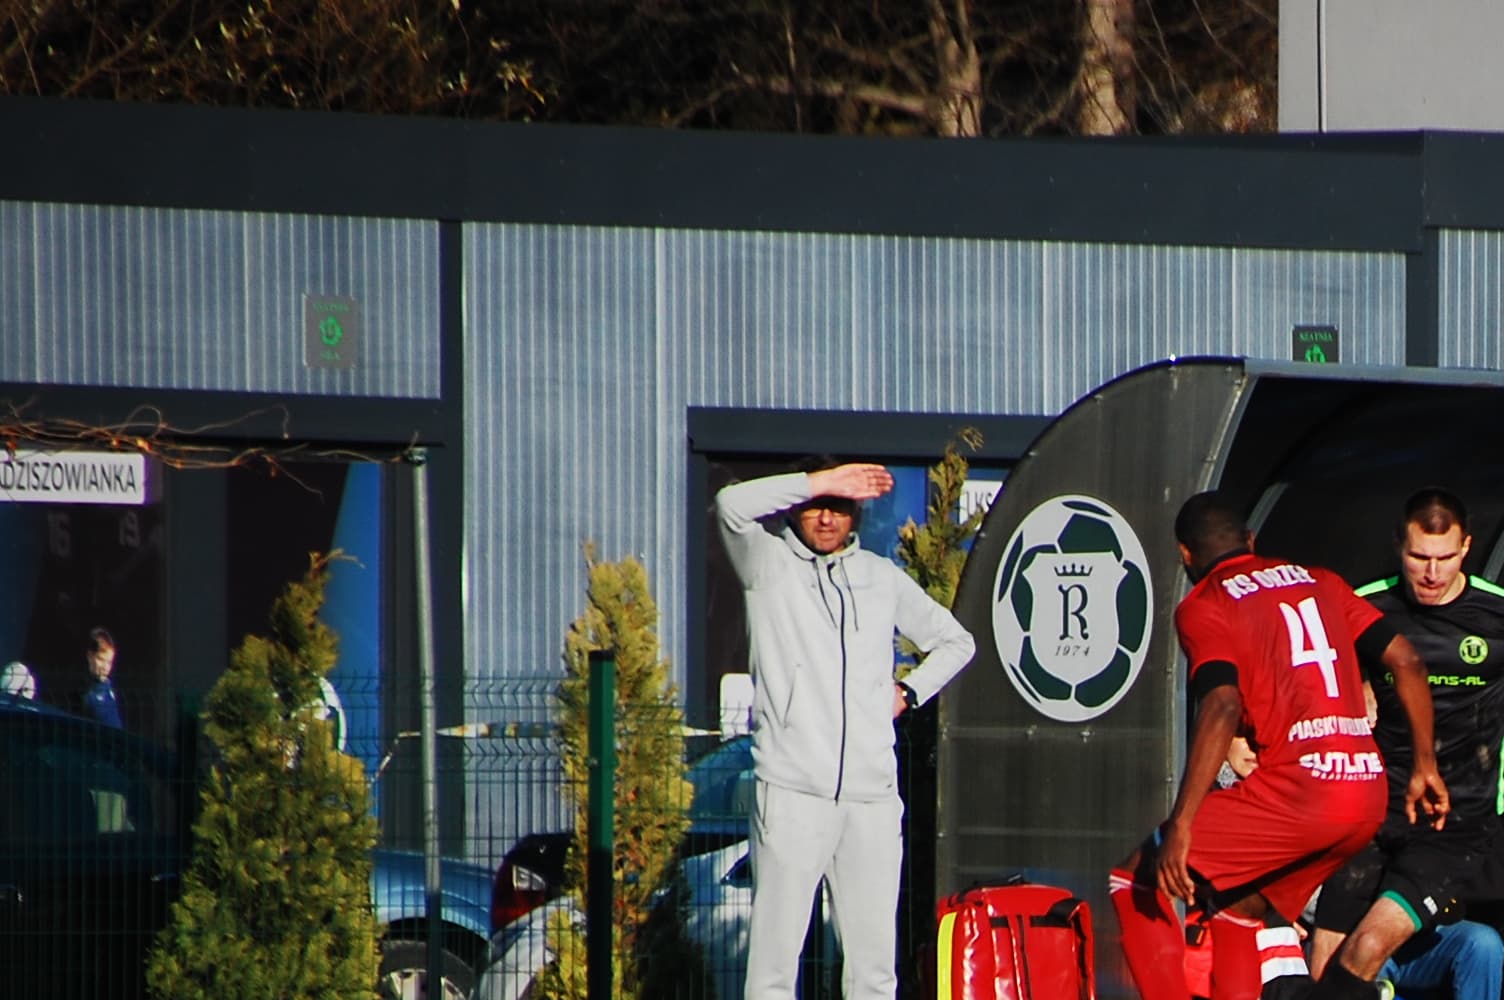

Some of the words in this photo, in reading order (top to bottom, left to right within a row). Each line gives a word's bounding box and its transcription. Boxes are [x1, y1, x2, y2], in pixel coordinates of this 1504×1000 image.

[0, 461, 138, 493] DZISZOWIANKA
[1057, 583, 1090, 641] R
[1054, 644, 1091, 657] 1974
[1278, 596, 1340, 699] 4
